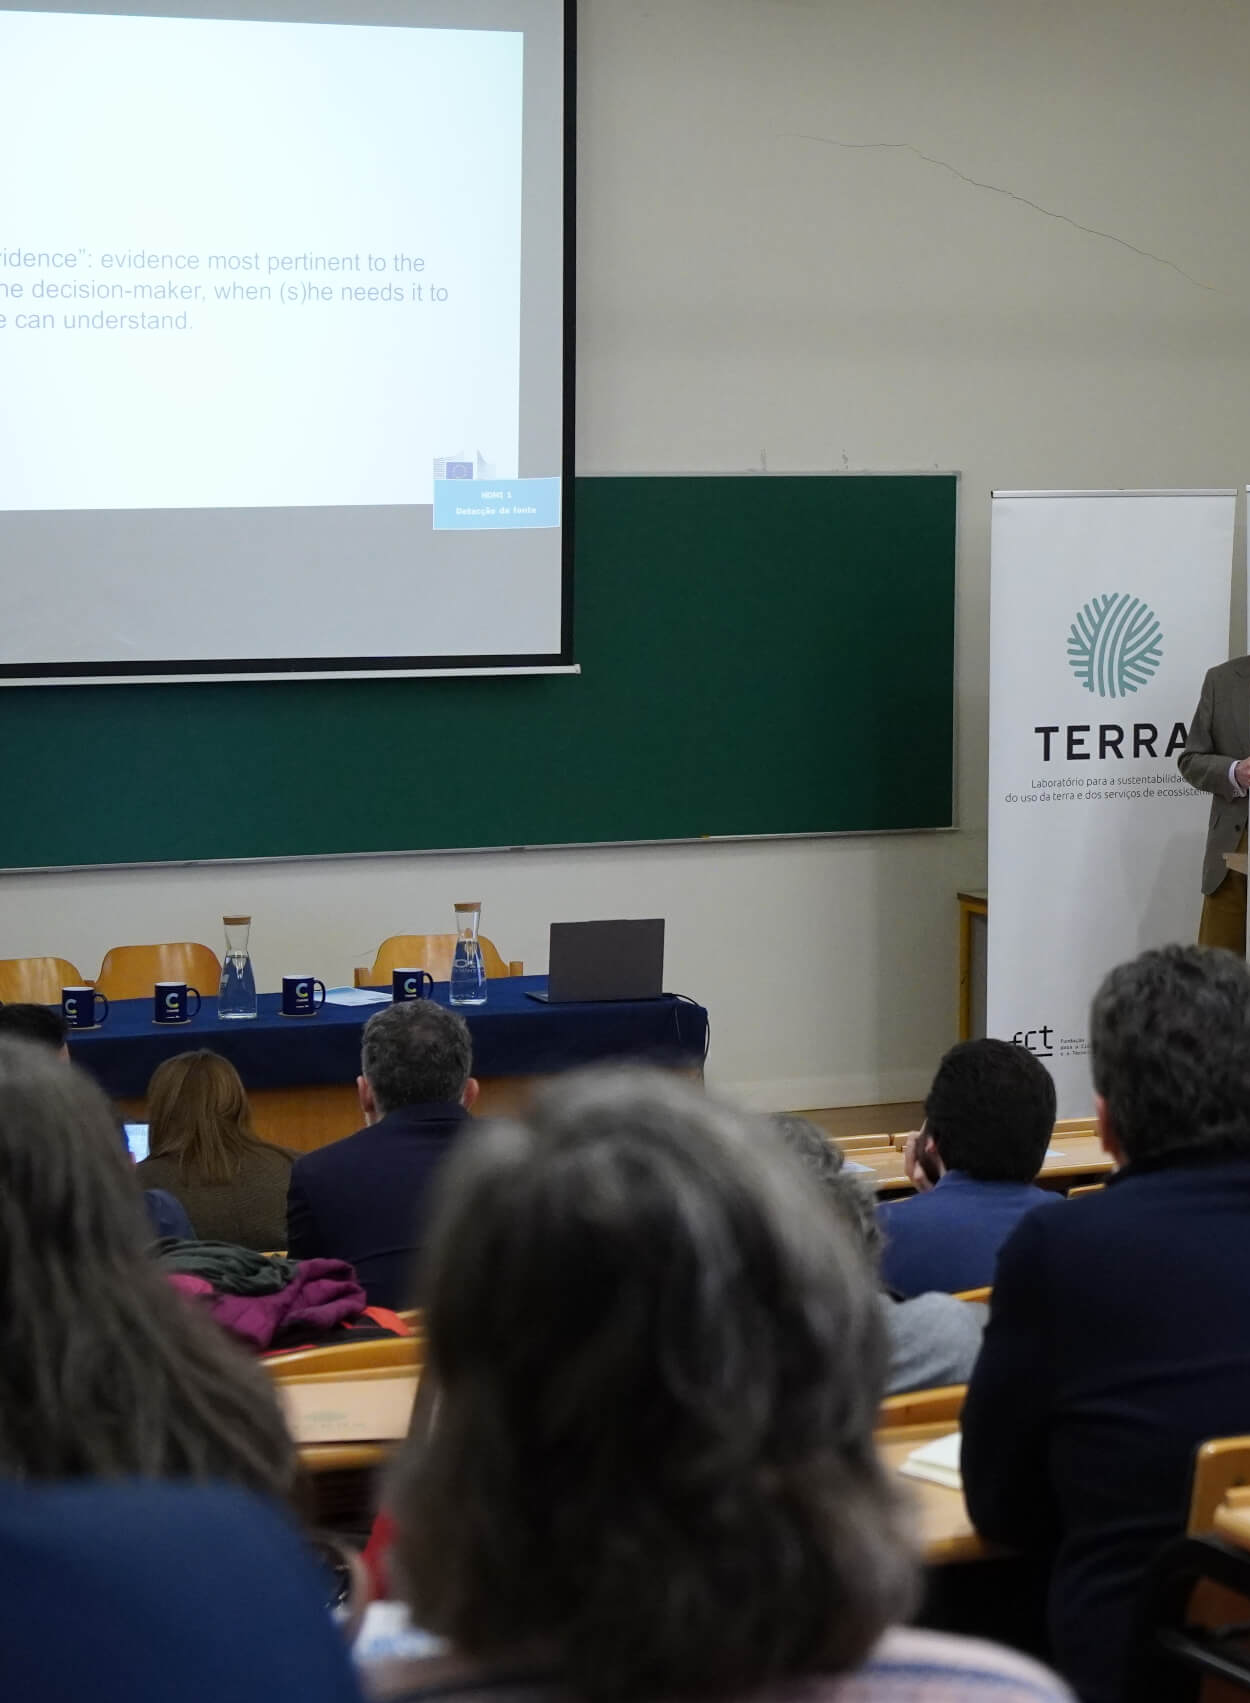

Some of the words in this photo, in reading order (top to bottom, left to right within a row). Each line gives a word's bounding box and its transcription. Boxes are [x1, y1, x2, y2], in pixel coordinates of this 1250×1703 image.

[0, 248, 92, 268] idence”:
[101, 250, 200, 270] evidence
[208, 252, 260, 270] most
[267, 252, 361, 275] pertinent
[368, 253, 387, 271] to
[394, 253, 425, 272] the
[32, 280, 206, 301] decision-maker,
[214, 281, 271, 301] when
[280, 281, 333, 304] (s)he
[341, 283, 405, 302] needs
[412, 283, 423, 302] it
[430, 284, 449, 302] to
[15, 313, 54, 329] can
[64, 310, 193, 330] understand.
[1034, 722, 1189, 762] TERRA
[1031, 776, 1085, 789] Laboratório
[1086, 777, 1108, 788] para
[1110, 778, 1115, 786] a
[1005, 792, 1018, 803] do
[1021, 793, 1037, 802] uso
[1039, 791, 1051, 801] da
[1052, 791, 1076, 801] terra
[1077, 792, 1083, 800] e
[1086, 789, 1102, 800] dos
[1105, 788, 1141, 801] serviços
[1143, 787, 1155, 797] de
